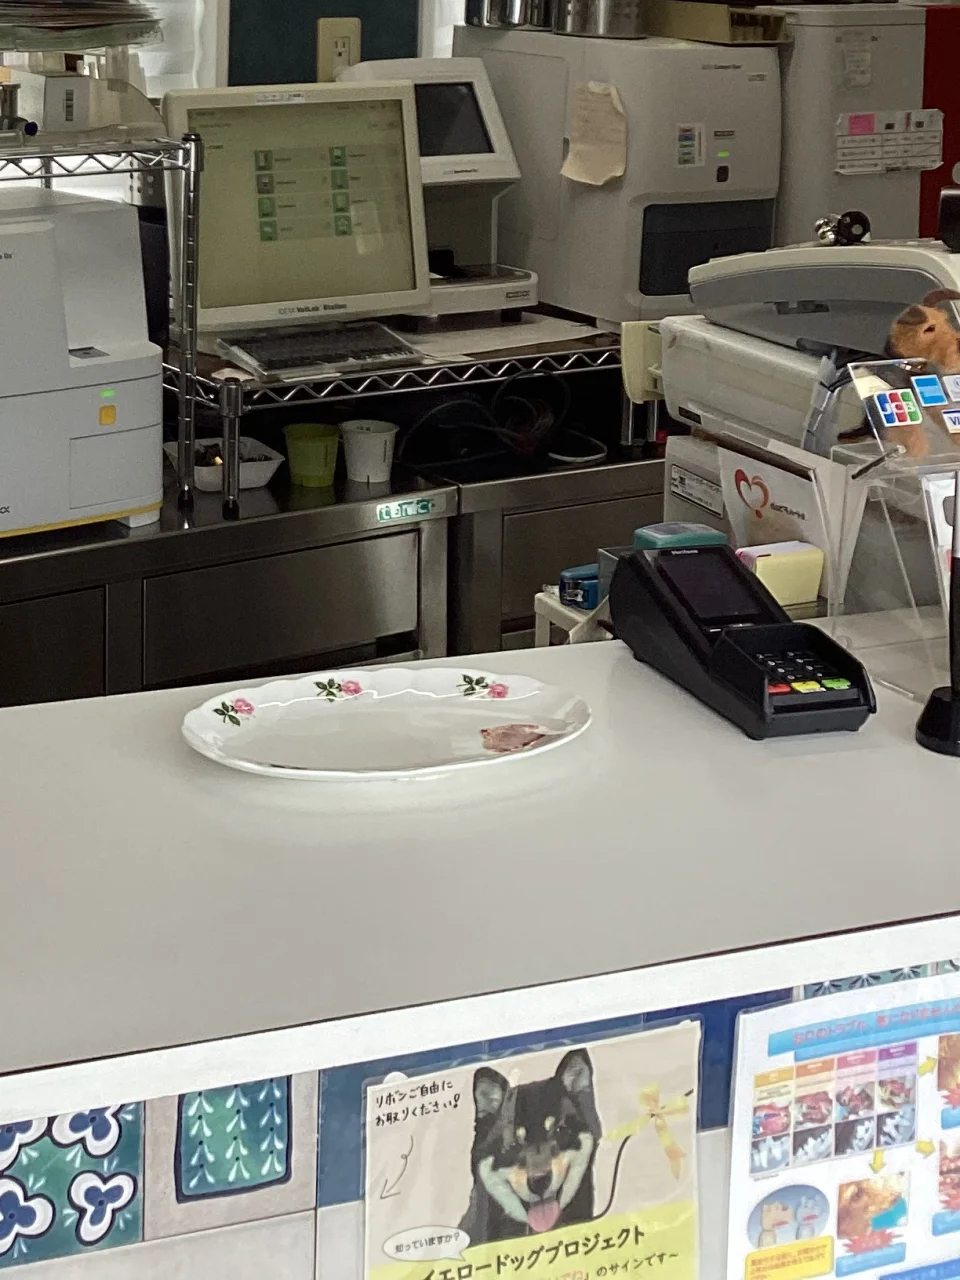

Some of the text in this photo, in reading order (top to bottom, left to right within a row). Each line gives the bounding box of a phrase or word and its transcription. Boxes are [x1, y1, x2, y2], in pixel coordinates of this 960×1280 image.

[880, 402, 916, 415] JCB
[376, 1080, 454, 1108] リボンご自由に
